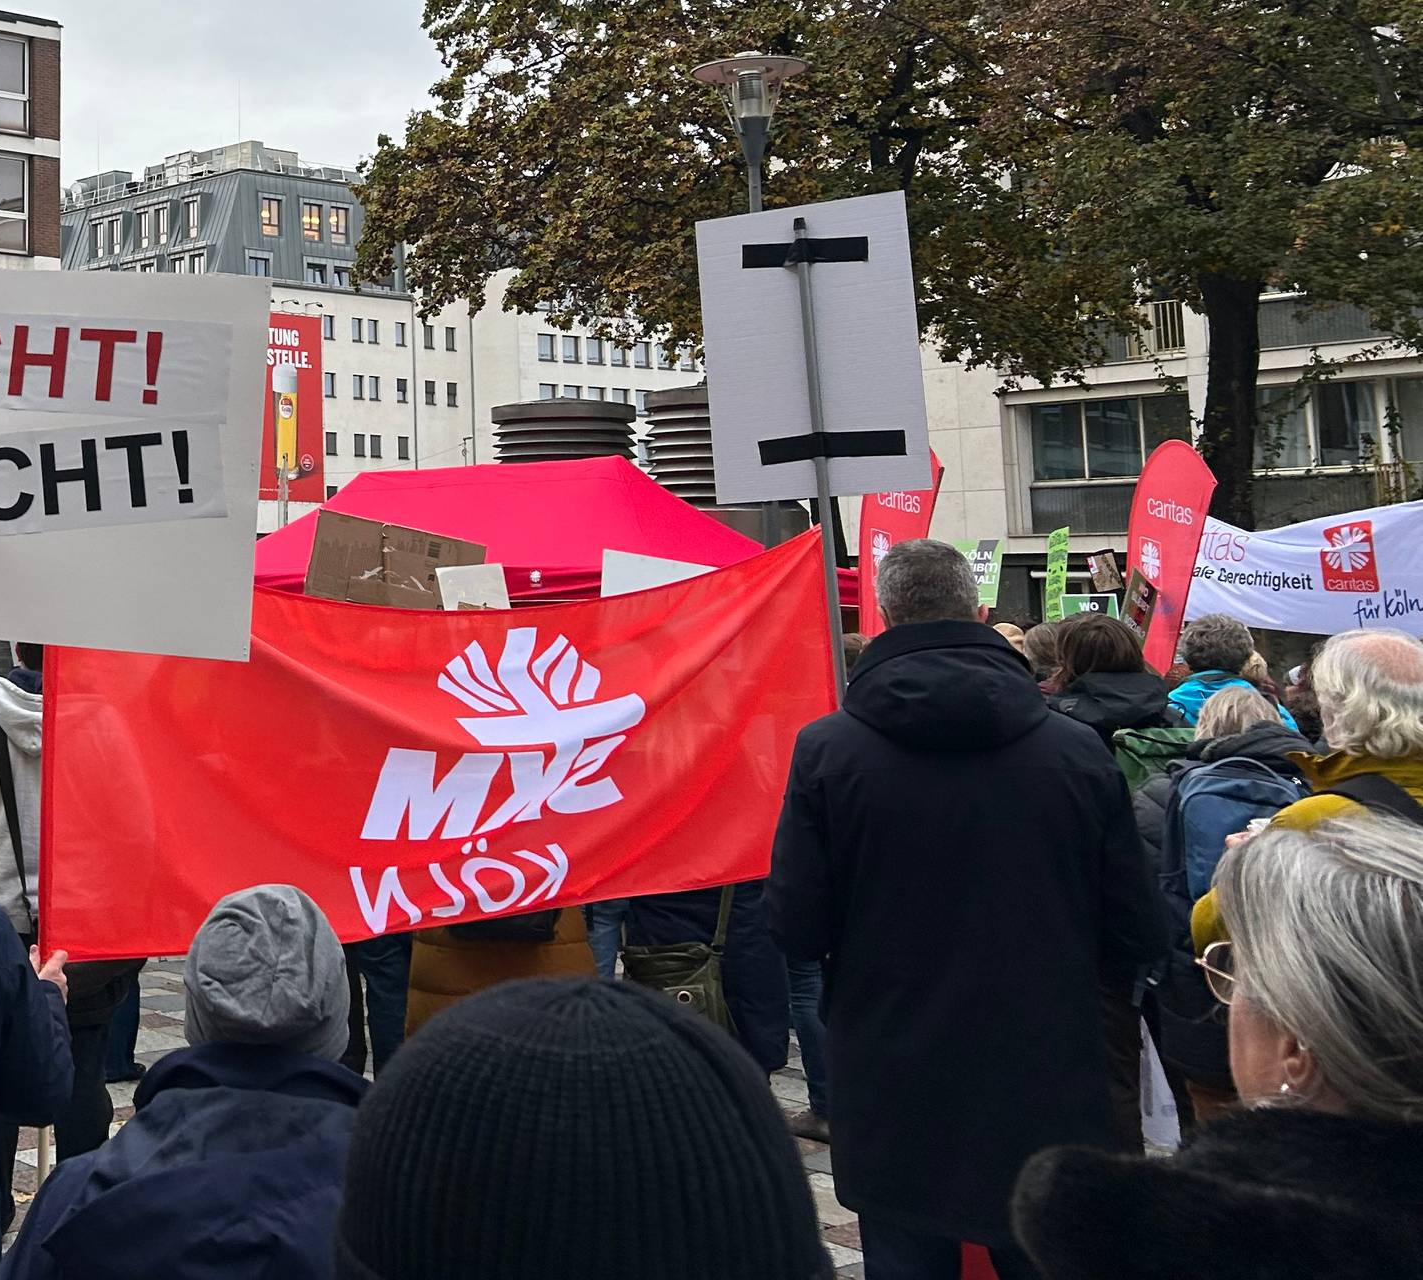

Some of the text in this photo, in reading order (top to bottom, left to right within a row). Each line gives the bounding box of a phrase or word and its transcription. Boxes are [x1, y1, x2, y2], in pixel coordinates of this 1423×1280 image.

[268, 328, 300, 347] TUNG
[266, 348, 313, 369] STELLE.
[1147, 498, 1193, 525] caritas
[1202, 525, 1250, 562] itas
[970, 562, 998, 573] IB(T)
[1218, 567, 1314, 592] Gerechtigkeit
[1327, 577, 1375, 591] caritas
[1079, 601, 1099, 612] WO
[1353, 597, 1380, 629] für
